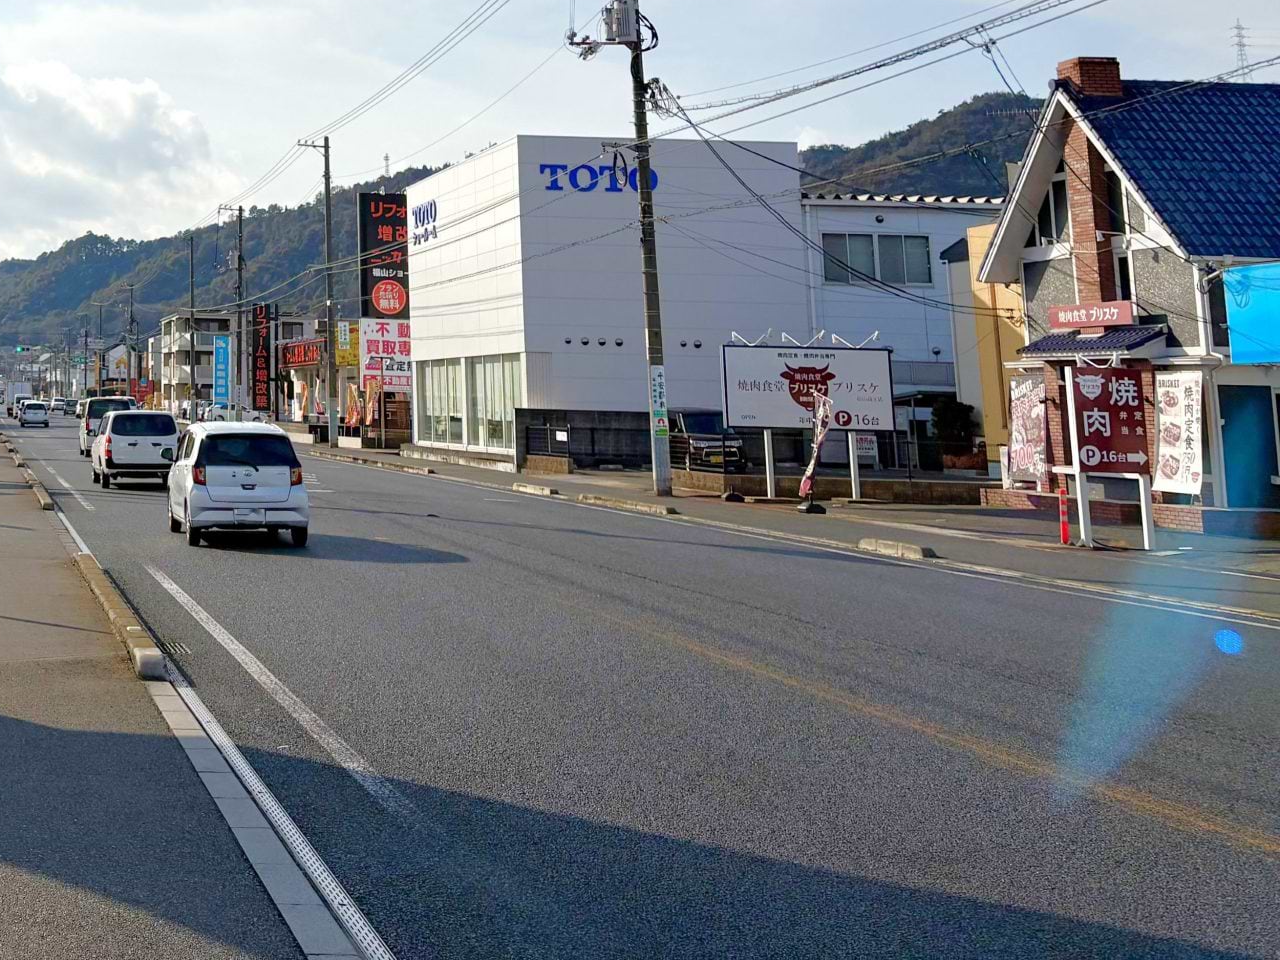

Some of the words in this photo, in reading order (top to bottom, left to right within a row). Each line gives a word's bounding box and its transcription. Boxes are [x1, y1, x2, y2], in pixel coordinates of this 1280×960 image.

[540, 164, 658, 192] TOTO
[412, 199, 437, 229] TOTO
[737, 379, 785, 393] 焼肉食堂
[832, 381, 880, 394] ブリスケ
